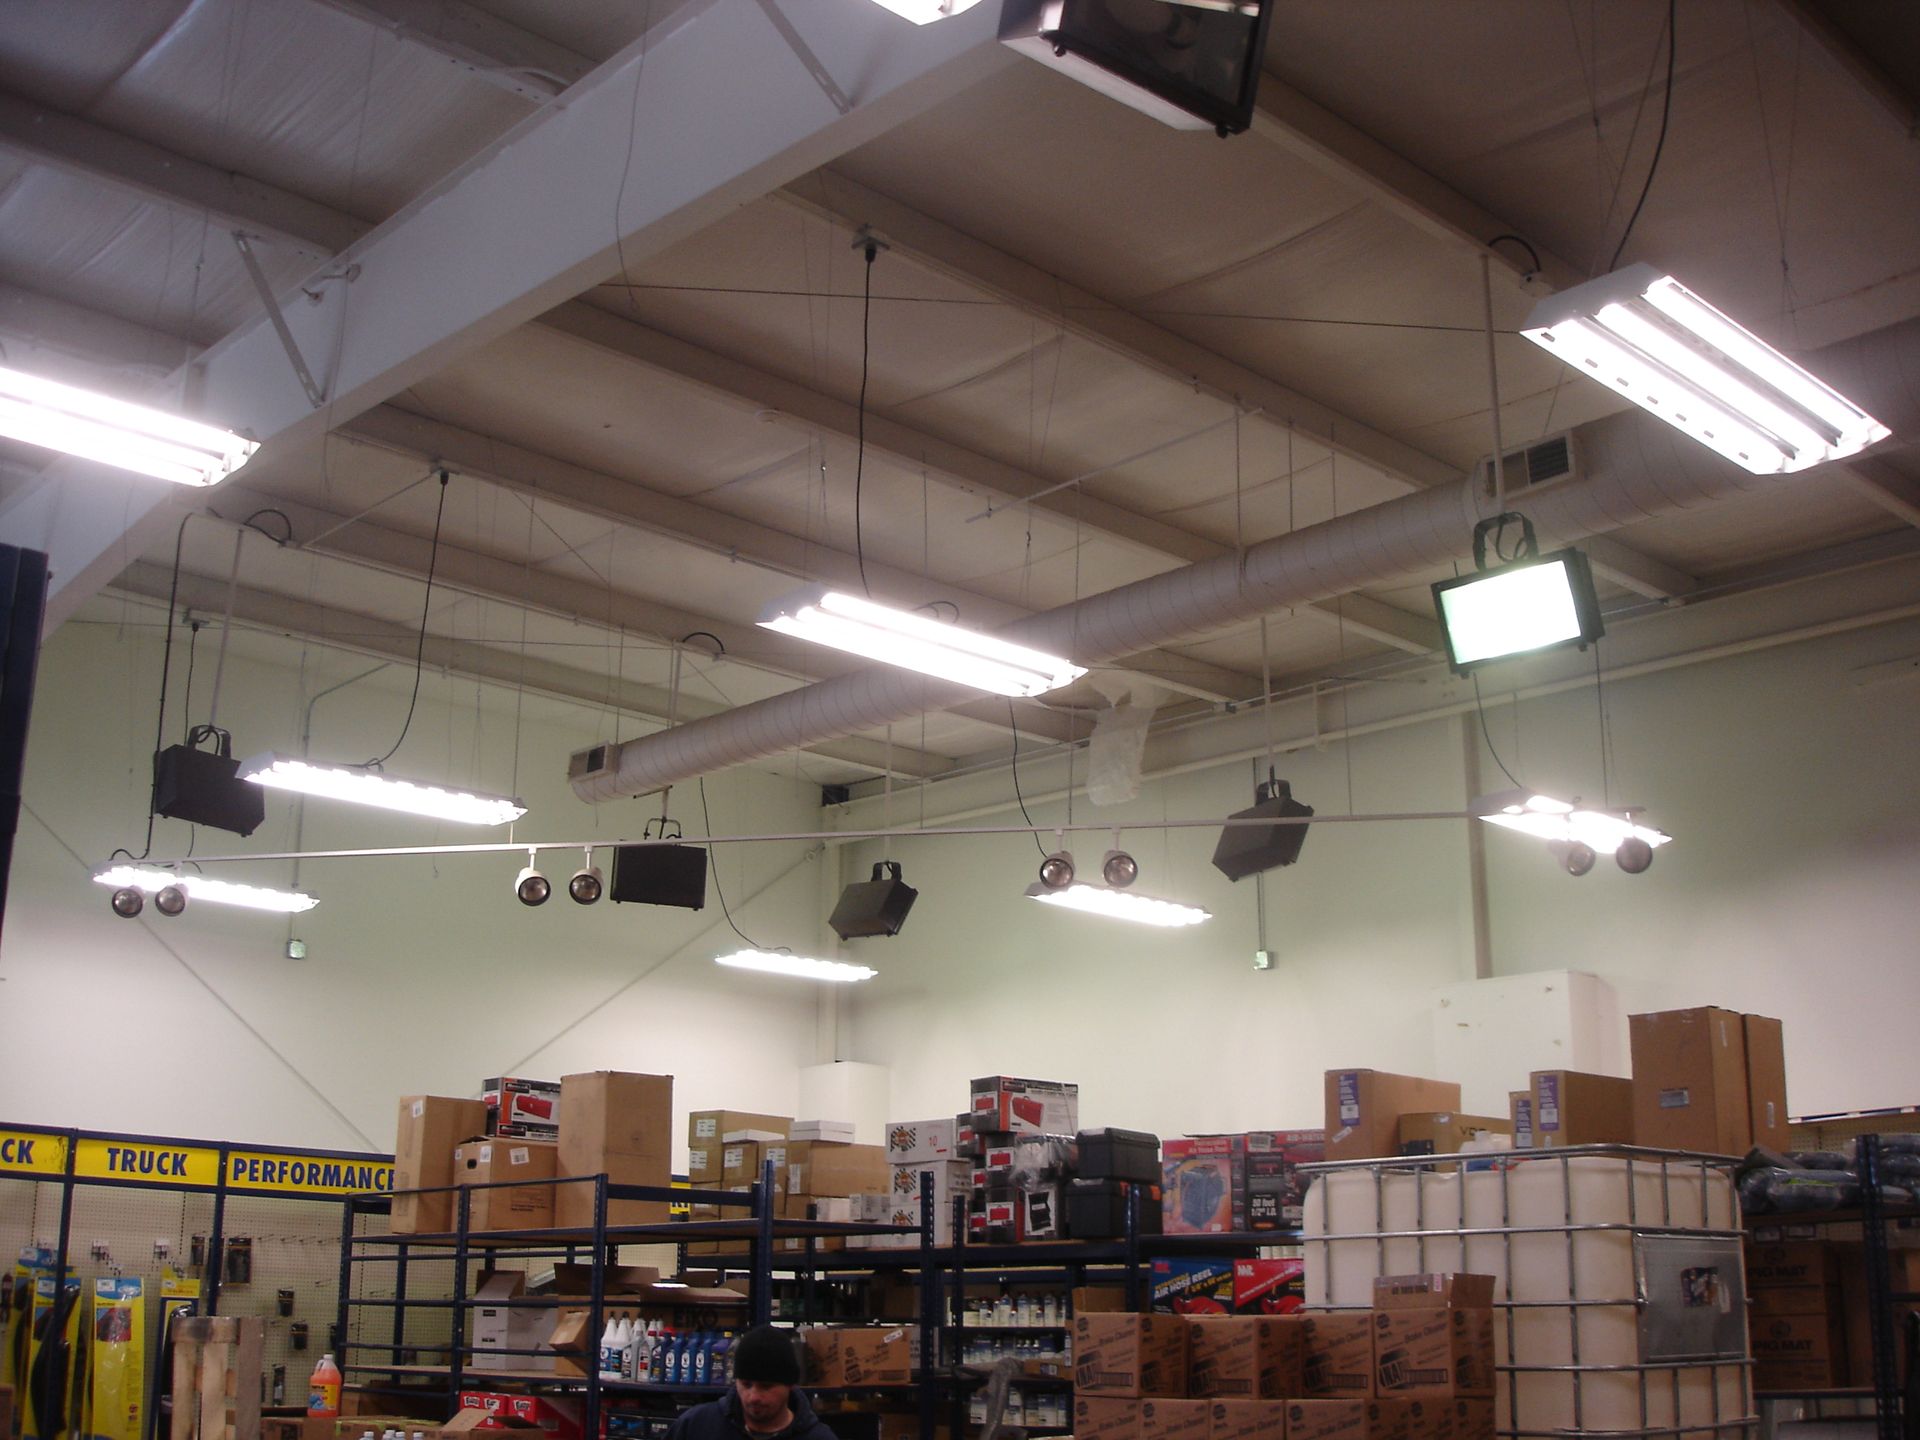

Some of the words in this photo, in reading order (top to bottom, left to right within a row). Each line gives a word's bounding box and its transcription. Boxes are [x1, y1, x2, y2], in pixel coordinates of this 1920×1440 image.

[1, 1139, 34, 1163] CK
[108, 1148, 187, 1176] TRUCK
[233, 1159, 394, 1190] PERFORMANCE
